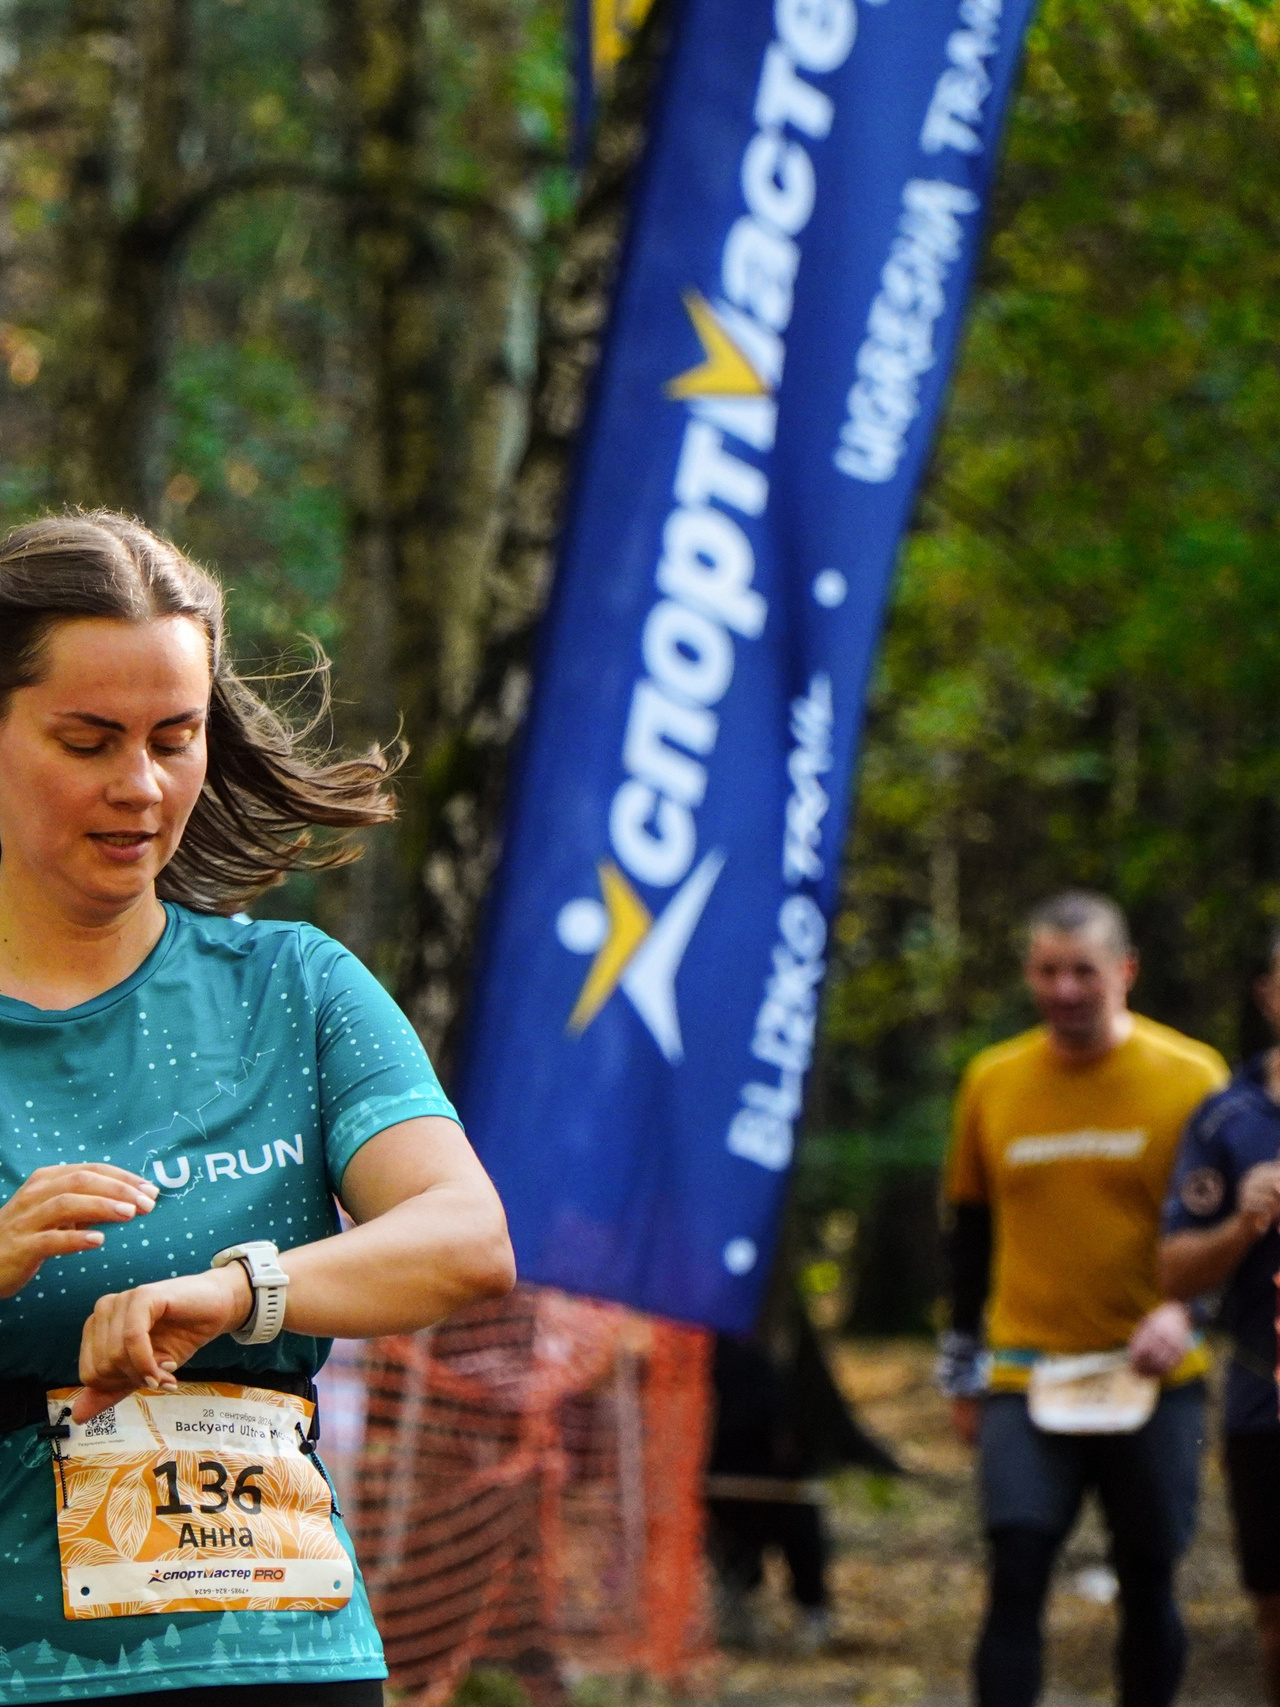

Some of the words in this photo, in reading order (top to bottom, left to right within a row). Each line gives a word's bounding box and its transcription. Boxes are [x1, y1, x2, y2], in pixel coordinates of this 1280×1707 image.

[152, 1159, 191, 1189] U
[205, 1134, 304, 1182] RUN
[202, 1408, 214, 1418] 28
[219, 1411, 256, 1422] сентября
[175, 1421, 235, 1434] Backyard
[239, 1425, 266, 1438] Ultra
[151, 1460, 264, 1516] 136
[178, 1522, 254, 1549] Анна
[253, 1569, 285, 1581] PRO
